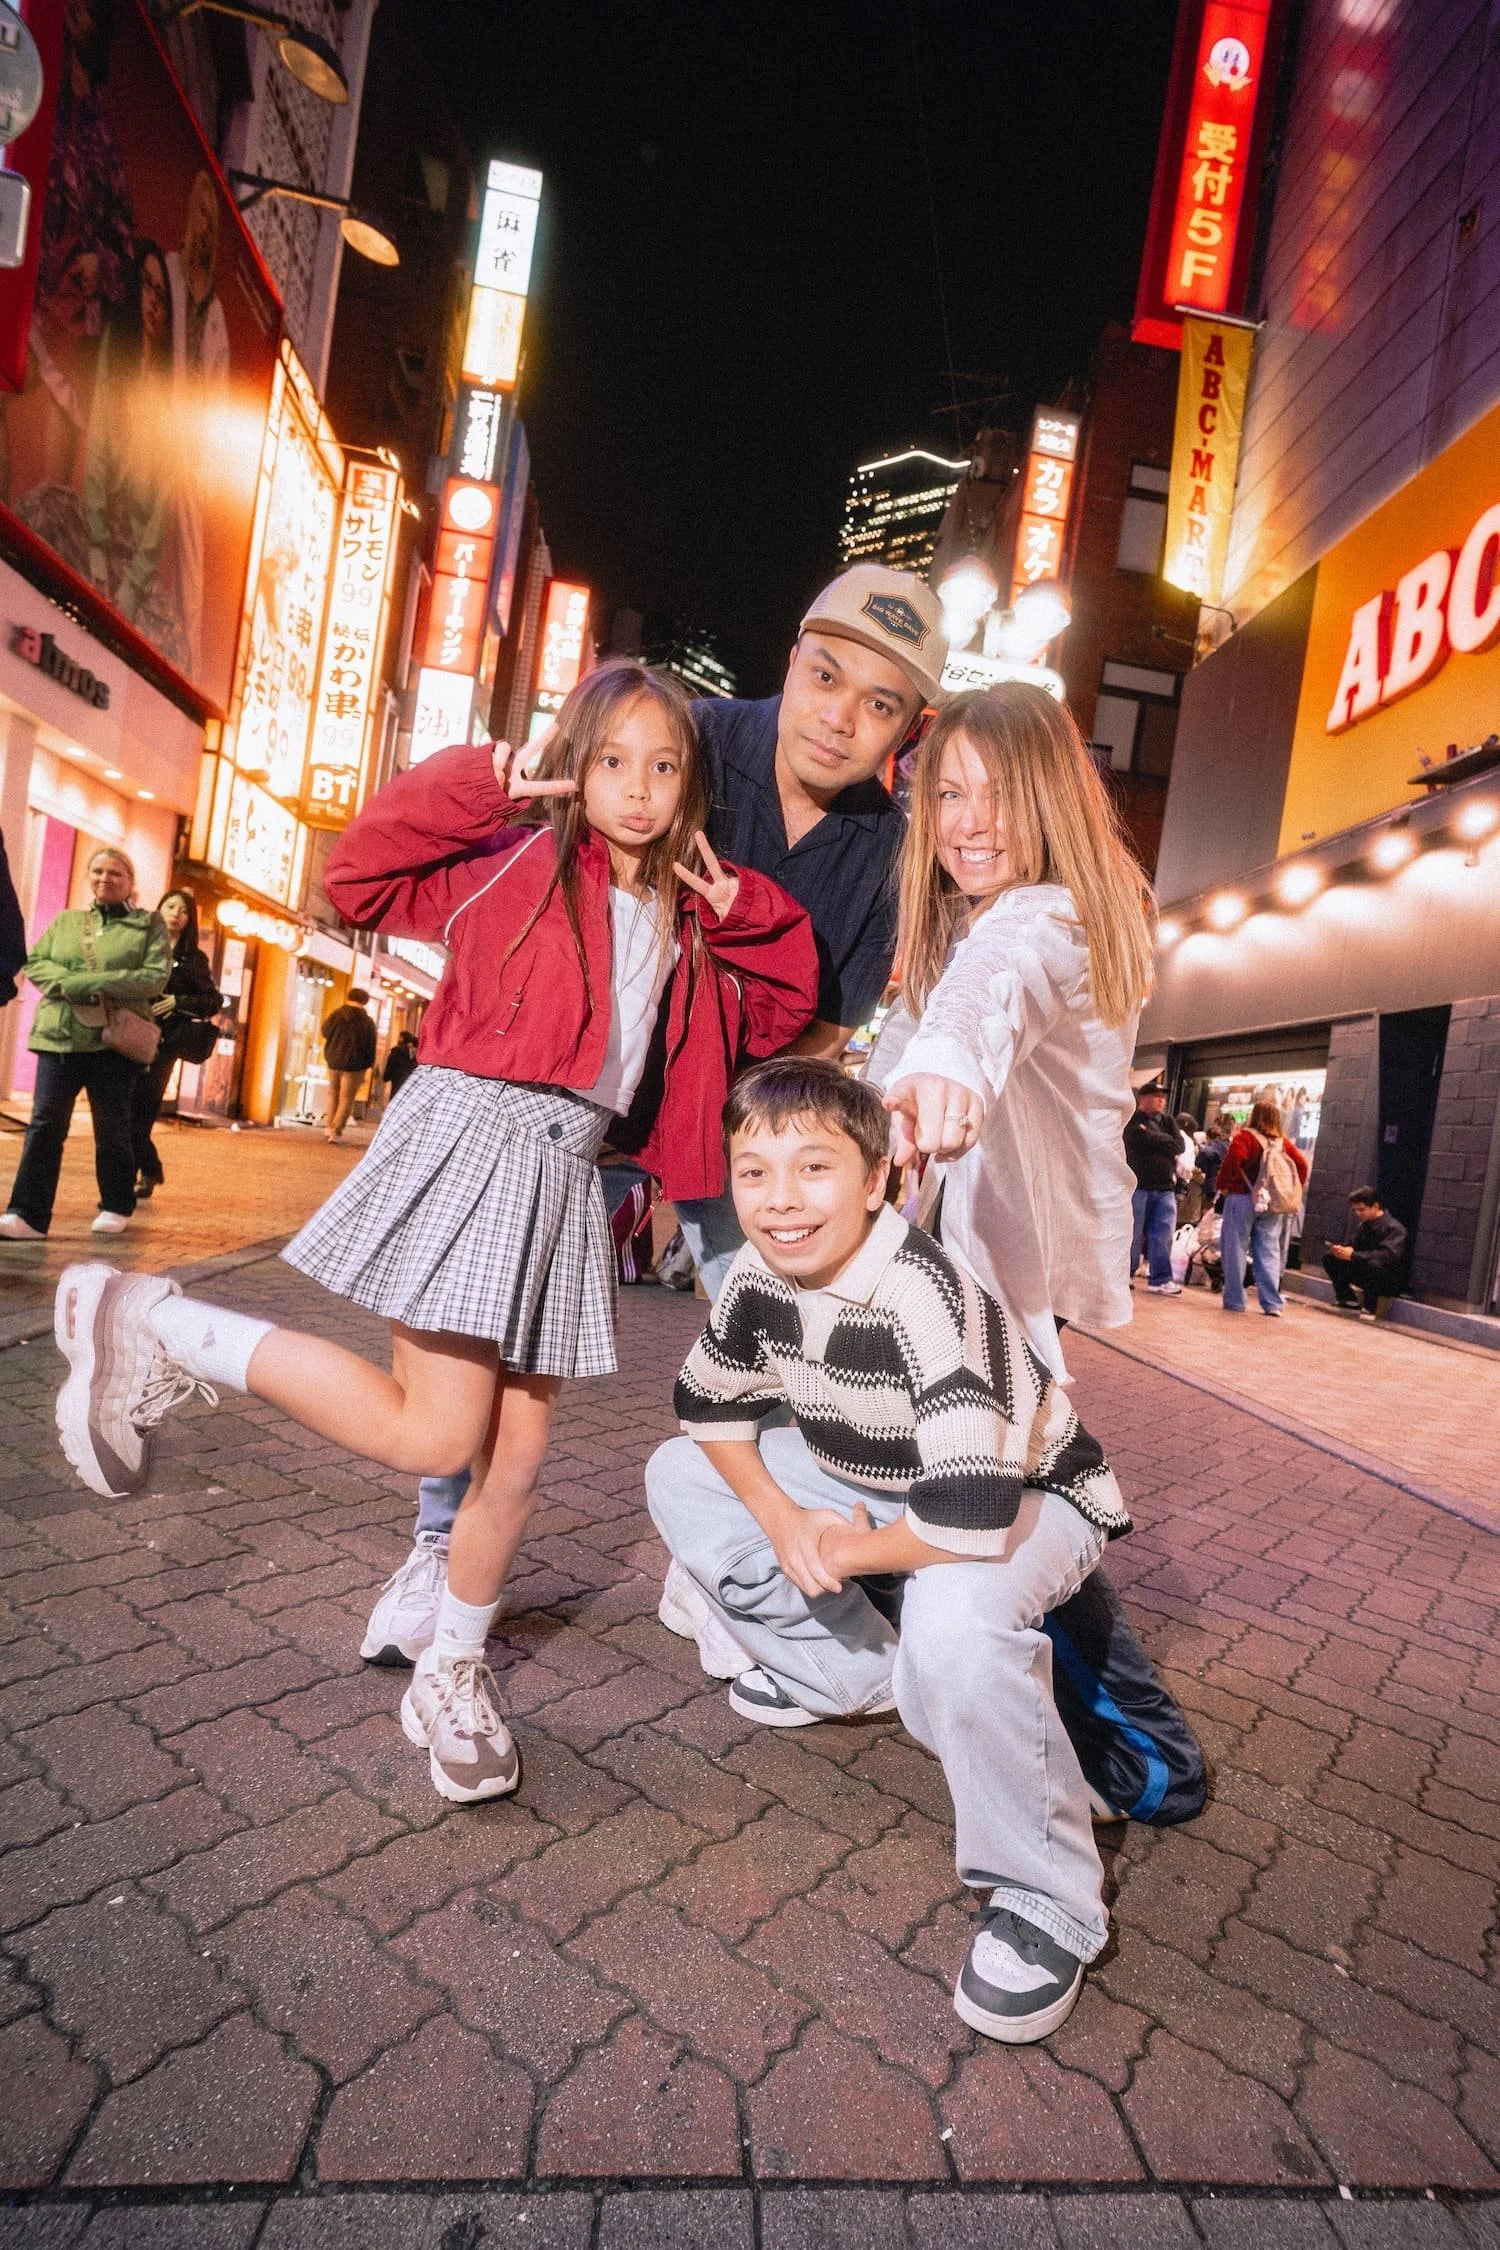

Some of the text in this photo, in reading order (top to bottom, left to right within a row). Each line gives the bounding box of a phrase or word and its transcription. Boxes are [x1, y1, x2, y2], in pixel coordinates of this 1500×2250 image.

[1179, 121, 1238, 288] 受付5F
[326, 642, 366, 720] かわ串
[1326, 503, 1500, 735] ABC
